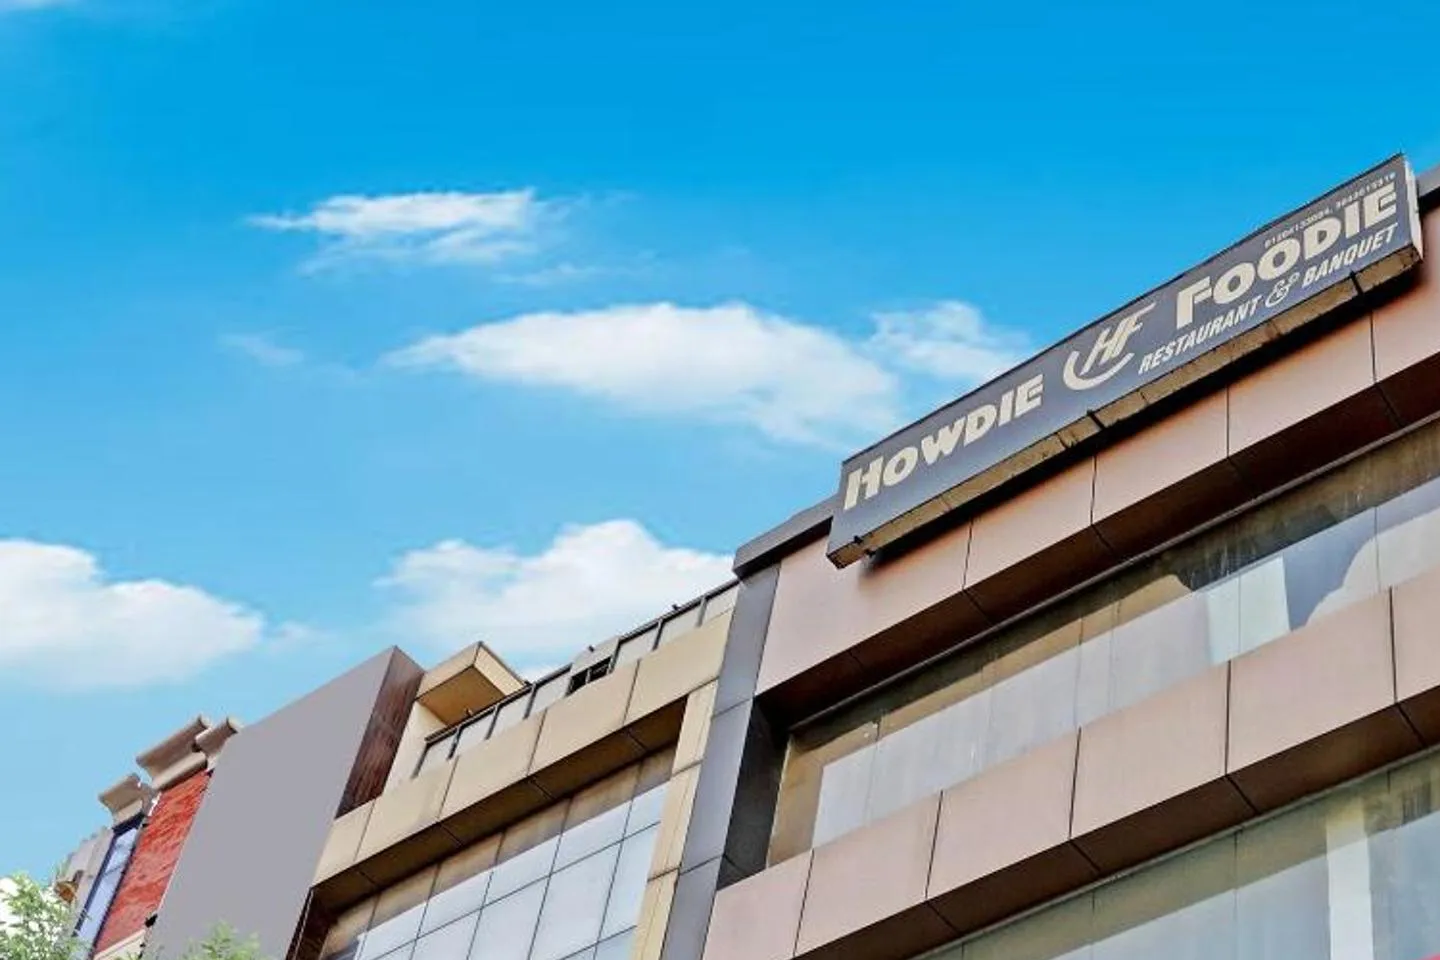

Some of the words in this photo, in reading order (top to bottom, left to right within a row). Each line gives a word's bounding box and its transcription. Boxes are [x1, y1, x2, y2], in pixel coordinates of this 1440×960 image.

[843, 373, 1044, 510] HOWDIE
[1175, 181, 1397, 329] FOODIE
[1138, 294, 1263, 374] RESTAURANT
[1264, 271, 1300, 308] &
[1301, 221, 1399, 289] BANQUET
